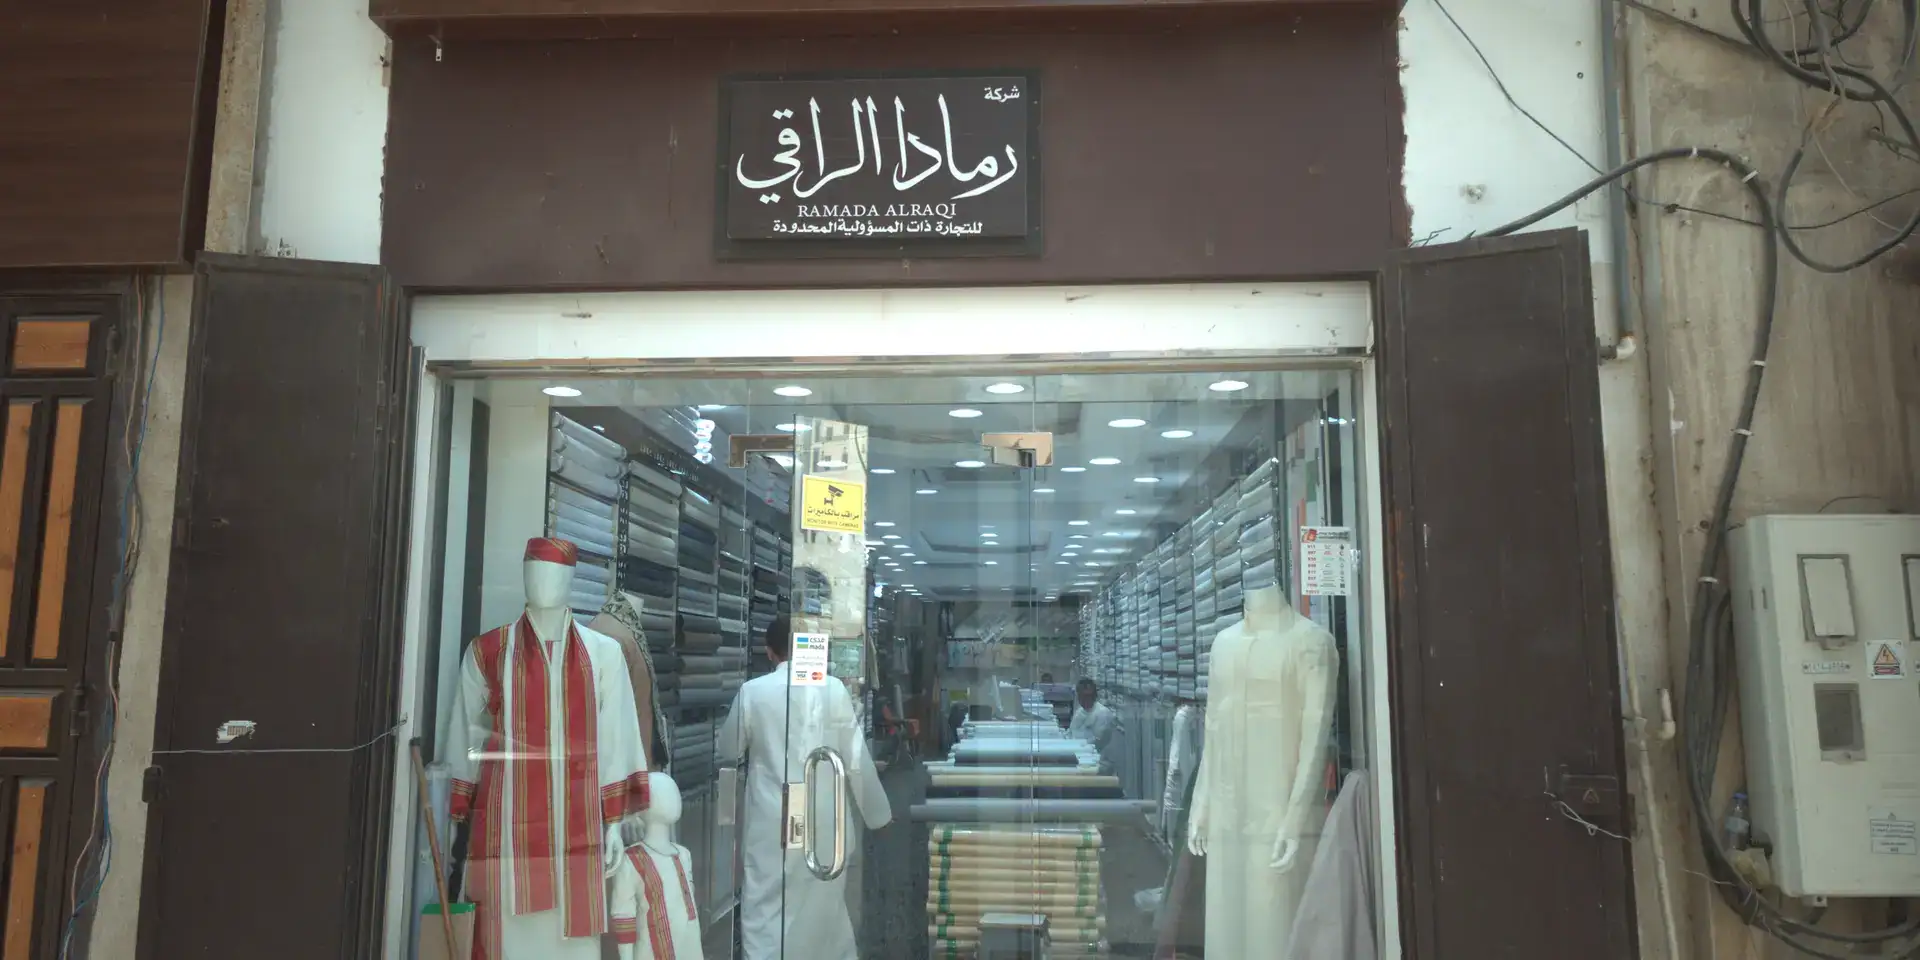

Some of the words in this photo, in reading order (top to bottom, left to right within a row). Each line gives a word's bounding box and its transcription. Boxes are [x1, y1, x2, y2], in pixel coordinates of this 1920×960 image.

[984, 85, 1020, 103] شركة
[736, 95, 882, 205] الراقي
[892, 93, 1018, 200] رمادا
[797, 204, 880, 217] RAMADA
[884, 203, 957, 219] ALRAQI
[773, 219, 838, 234] المحدودة
[906, 219, 932, 233] ذات
[935, 220, 983, 236] للتجارة
